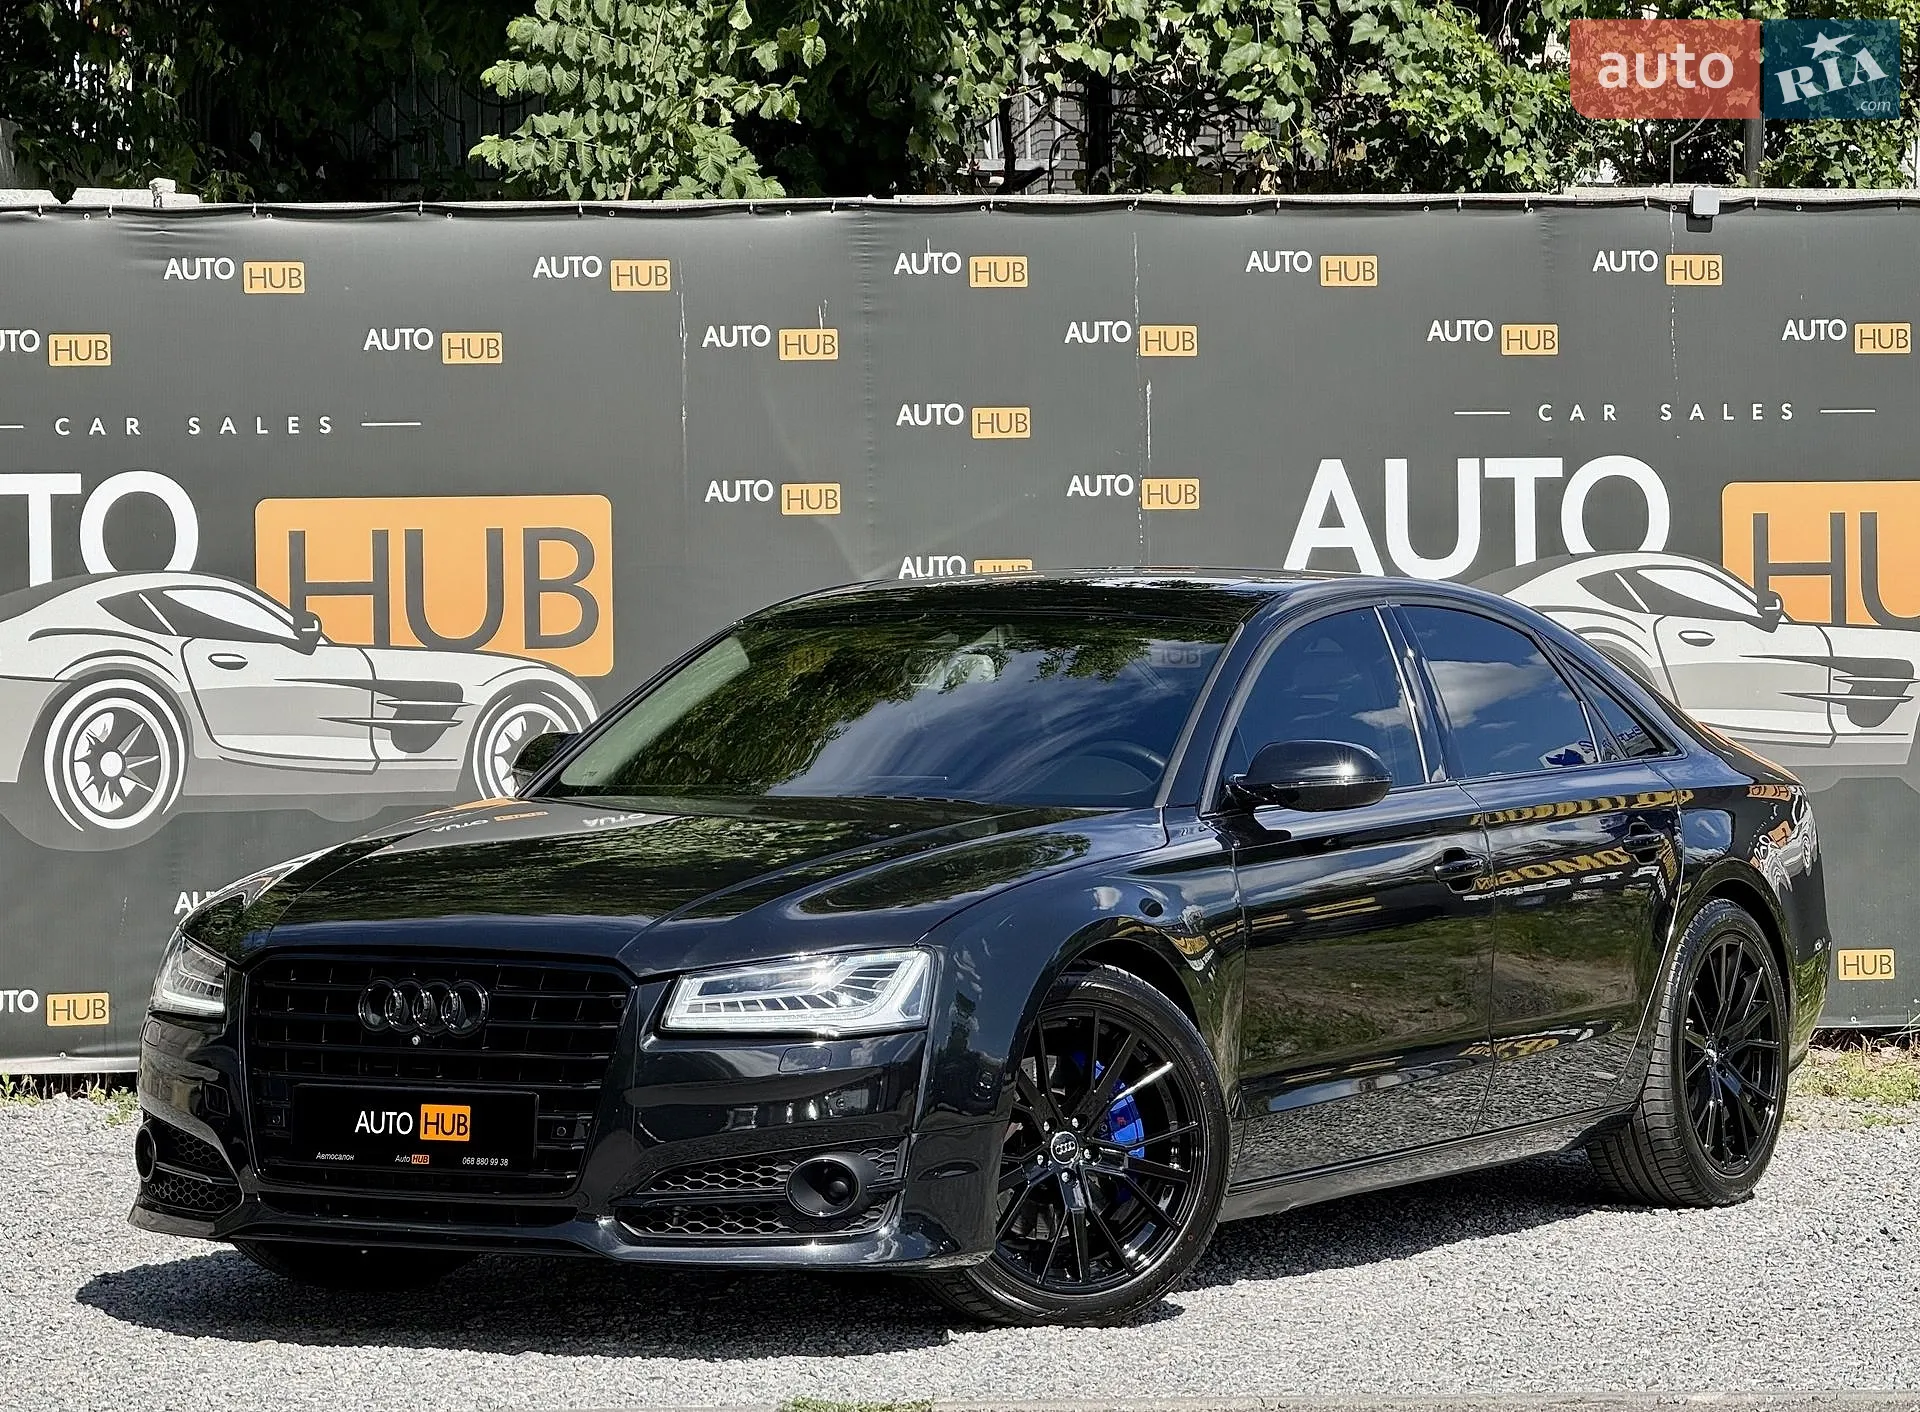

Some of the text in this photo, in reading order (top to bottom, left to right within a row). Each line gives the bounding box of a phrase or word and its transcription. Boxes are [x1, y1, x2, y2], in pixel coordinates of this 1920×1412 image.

[164, 258, 302, 289] AUTO HUB
[533, 256, 668, 287] AUTO HUB
[894, 253, 1025, 283] AUTO HUB
[1246, 251, 1375, 282] AUTO HUB
[1593, 250, 1720, 281] AUTO HUB
[364, 328, 500, 359] AUTO HUB
[702, 325, 836, 356] AUTO HUB
[1065, 321, 1195, 352] AUTO HUB
[1427, 320, 1556, 351] AUTO HUB
[1782, 319, 1909, 349] AUTO HUB
[54, 339, 109, 362] HUB
[54, 416, 333, 436] CAR SALES
[896, 404, 1028, 434] AUTO HUB
[1538, 403, 1796, 422] CAR SALES
[705, 480, 838, 510] AUTO HUB
[1067, 474, 1197, 505] AUTO HUB
[1283, 455, 1670, 580] AUTO
[899, 556, 967, 579] AUTO
[288, 527, 600, 650] HUB
[1843, 954, 1892, 976] HUB
[0, 990, 107, 1021] TO HUB
[355, 1110, 469, 1137] AUTO HUB
[315, 1151, 355, 1161] Автосалон
[394, 1154, 429, 1163] Auto HUB
[462, 1156, 476, 1165] 068
[489, 1158, 499, 1166] 99
[499, 1158, 509, 1166] 38
